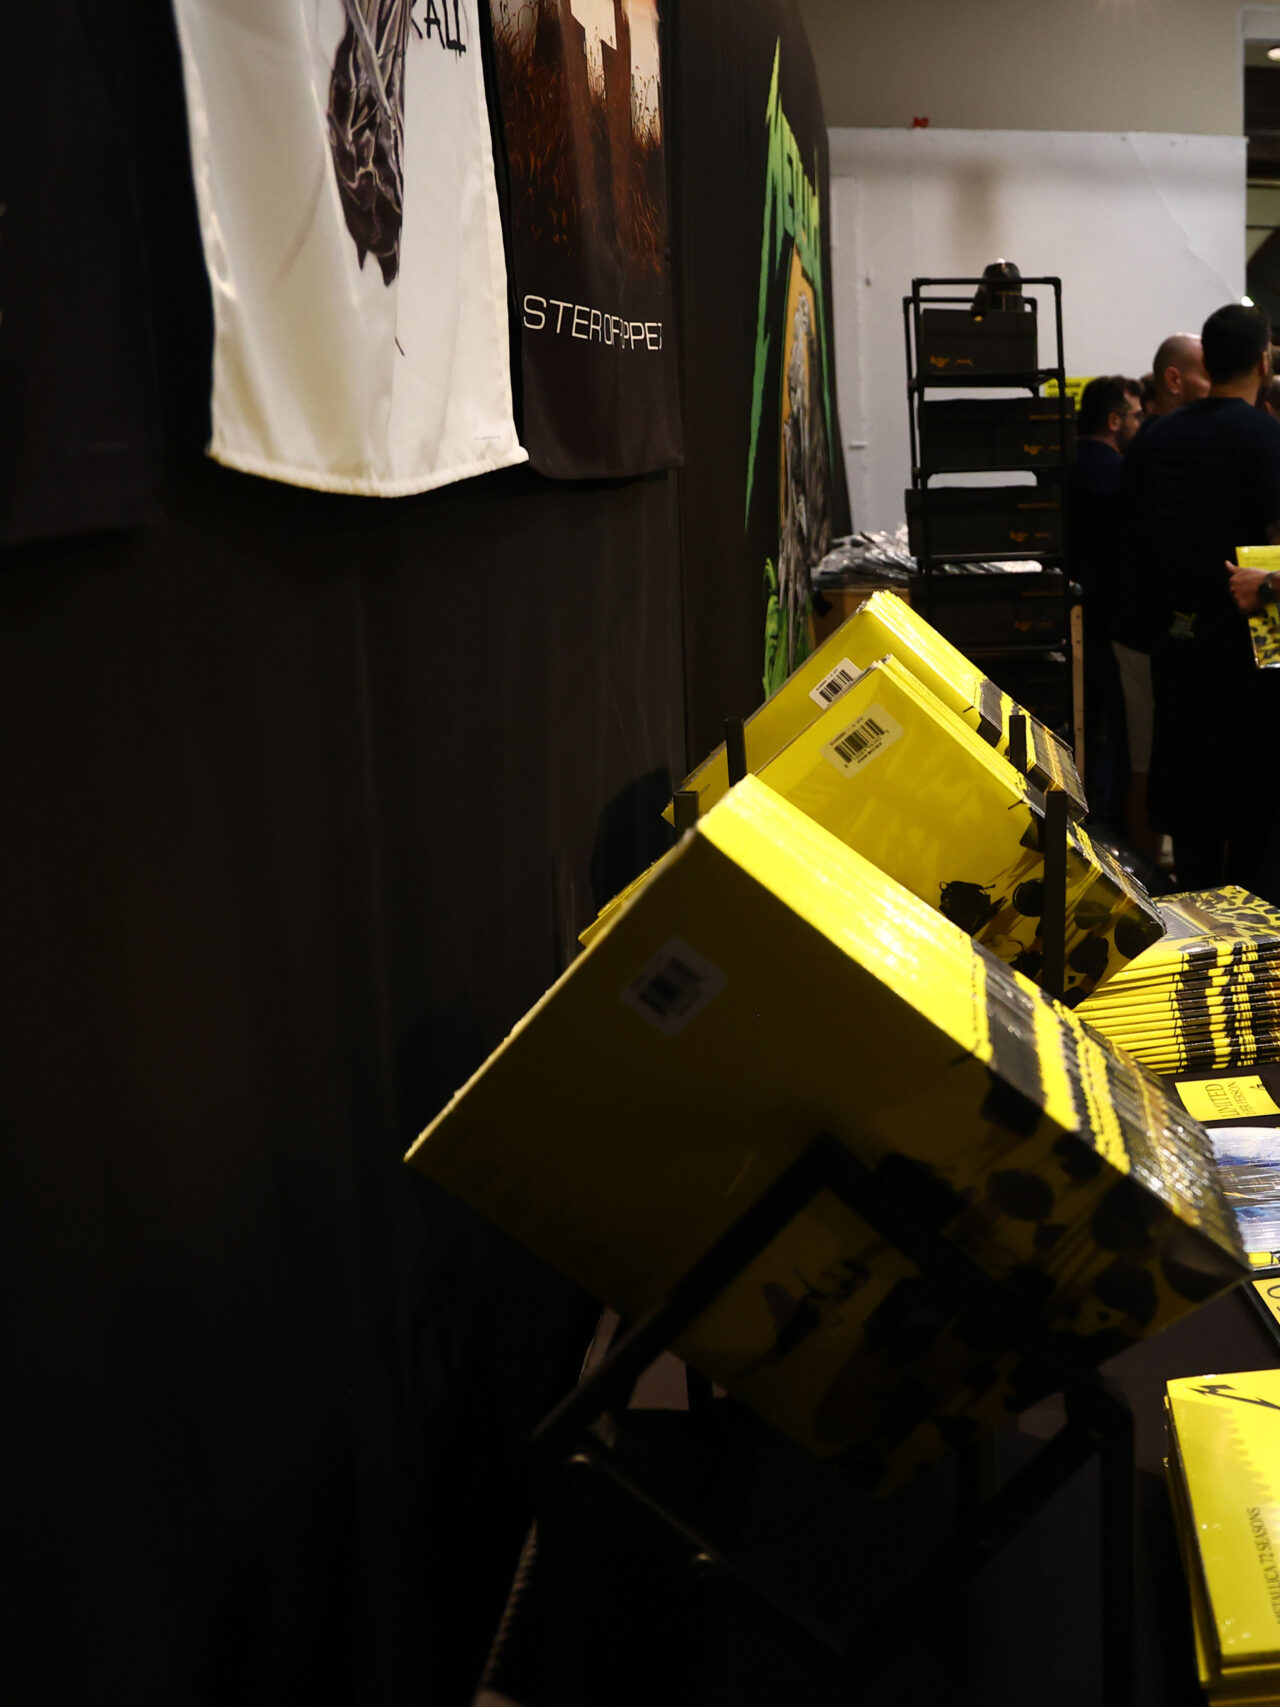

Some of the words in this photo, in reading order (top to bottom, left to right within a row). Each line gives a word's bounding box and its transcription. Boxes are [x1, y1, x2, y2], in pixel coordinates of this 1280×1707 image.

[523, 294, 602, 343] STER
[1205, 1083, 1241, 1118] LIMITED
[1246, 1506, 1274, 1553] SEASONS
